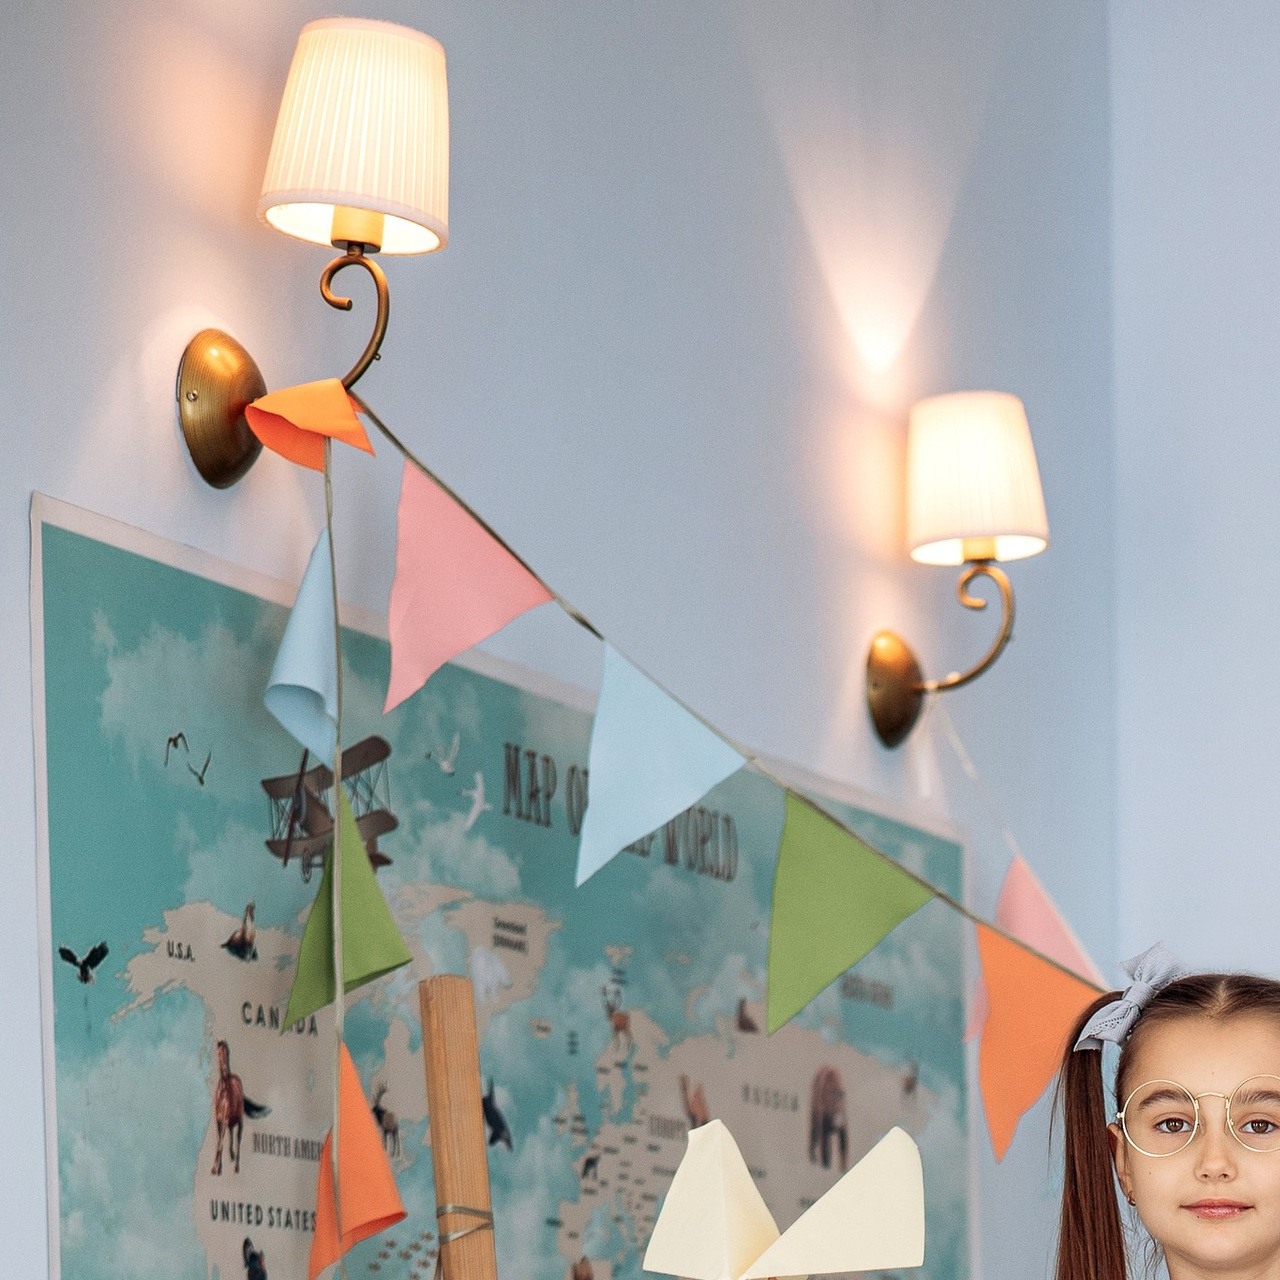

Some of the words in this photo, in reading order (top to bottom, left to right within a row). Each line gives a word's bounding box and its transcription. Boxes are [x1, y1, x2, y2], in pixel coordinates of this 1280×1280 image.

[503, 741, 557, 829] MAP
[167, 939, 195, 962] U.S.A.
[242, 1001, 318, 1037] CANDA
[211, 1199, 263, 1227] UNITED
[268, 1204, 316, 1233] STATES
